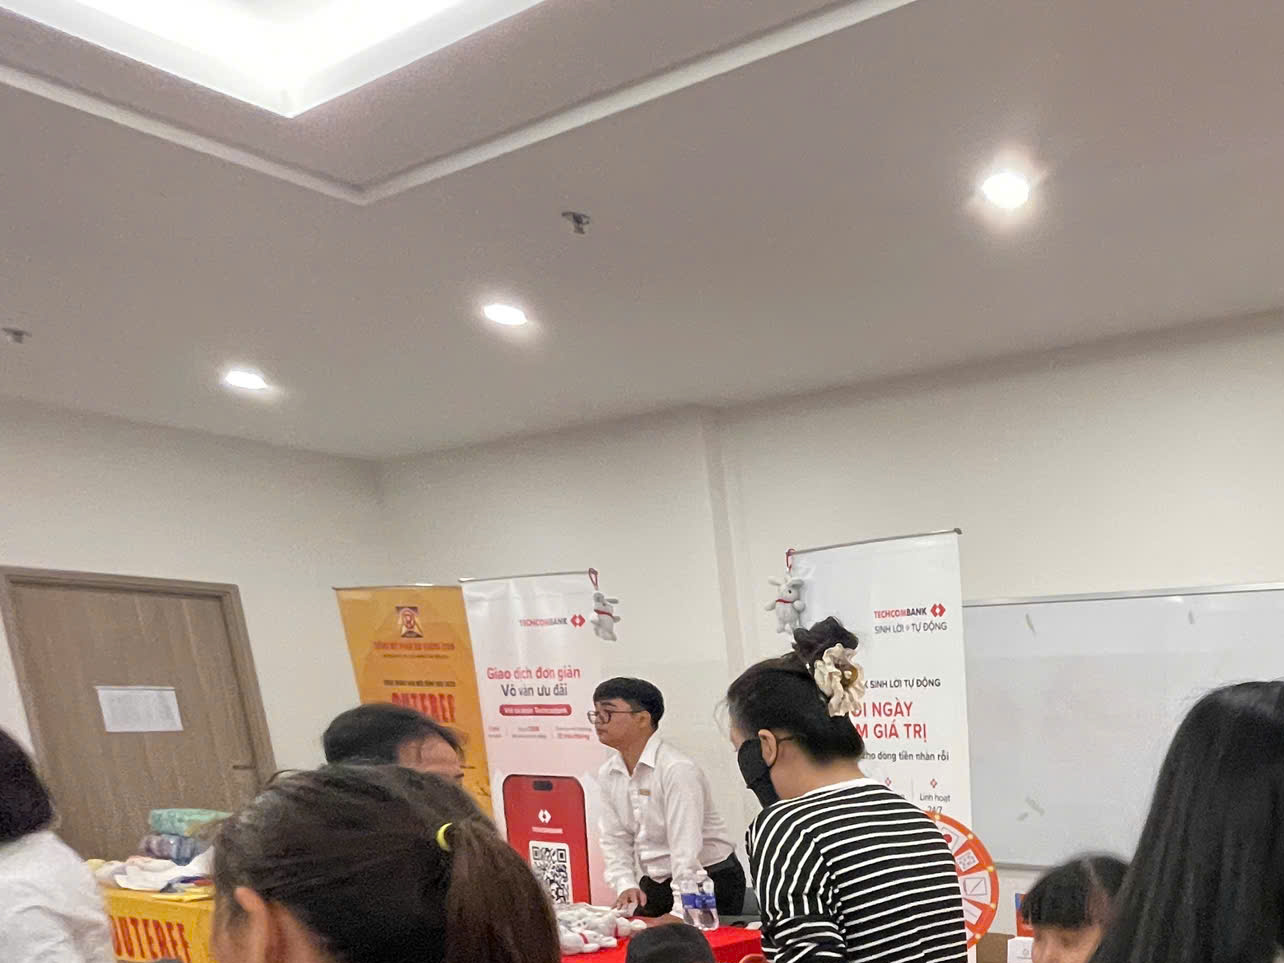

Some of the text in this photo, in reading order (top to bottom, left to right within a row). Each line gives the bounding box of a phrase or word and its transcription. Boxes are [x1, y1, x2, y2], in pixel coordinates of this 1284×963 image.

[874, 607, 927, 618] TECHCOMBANK
[875, 625, 891, 634] SINH
[923, 620, 947, 632] ĐỘNG
[487, 667, 511, 679] Giao
[870, 680, 887, 689] SINH
[916, 676, 941, 689] ĐỘNG
[872, 697, 912, 717] NGÀY
[873, 719, 899, 739] GIÁ
[904, 723, 927, 743] TRỊ
[919, 793, 933, 801] Linh
